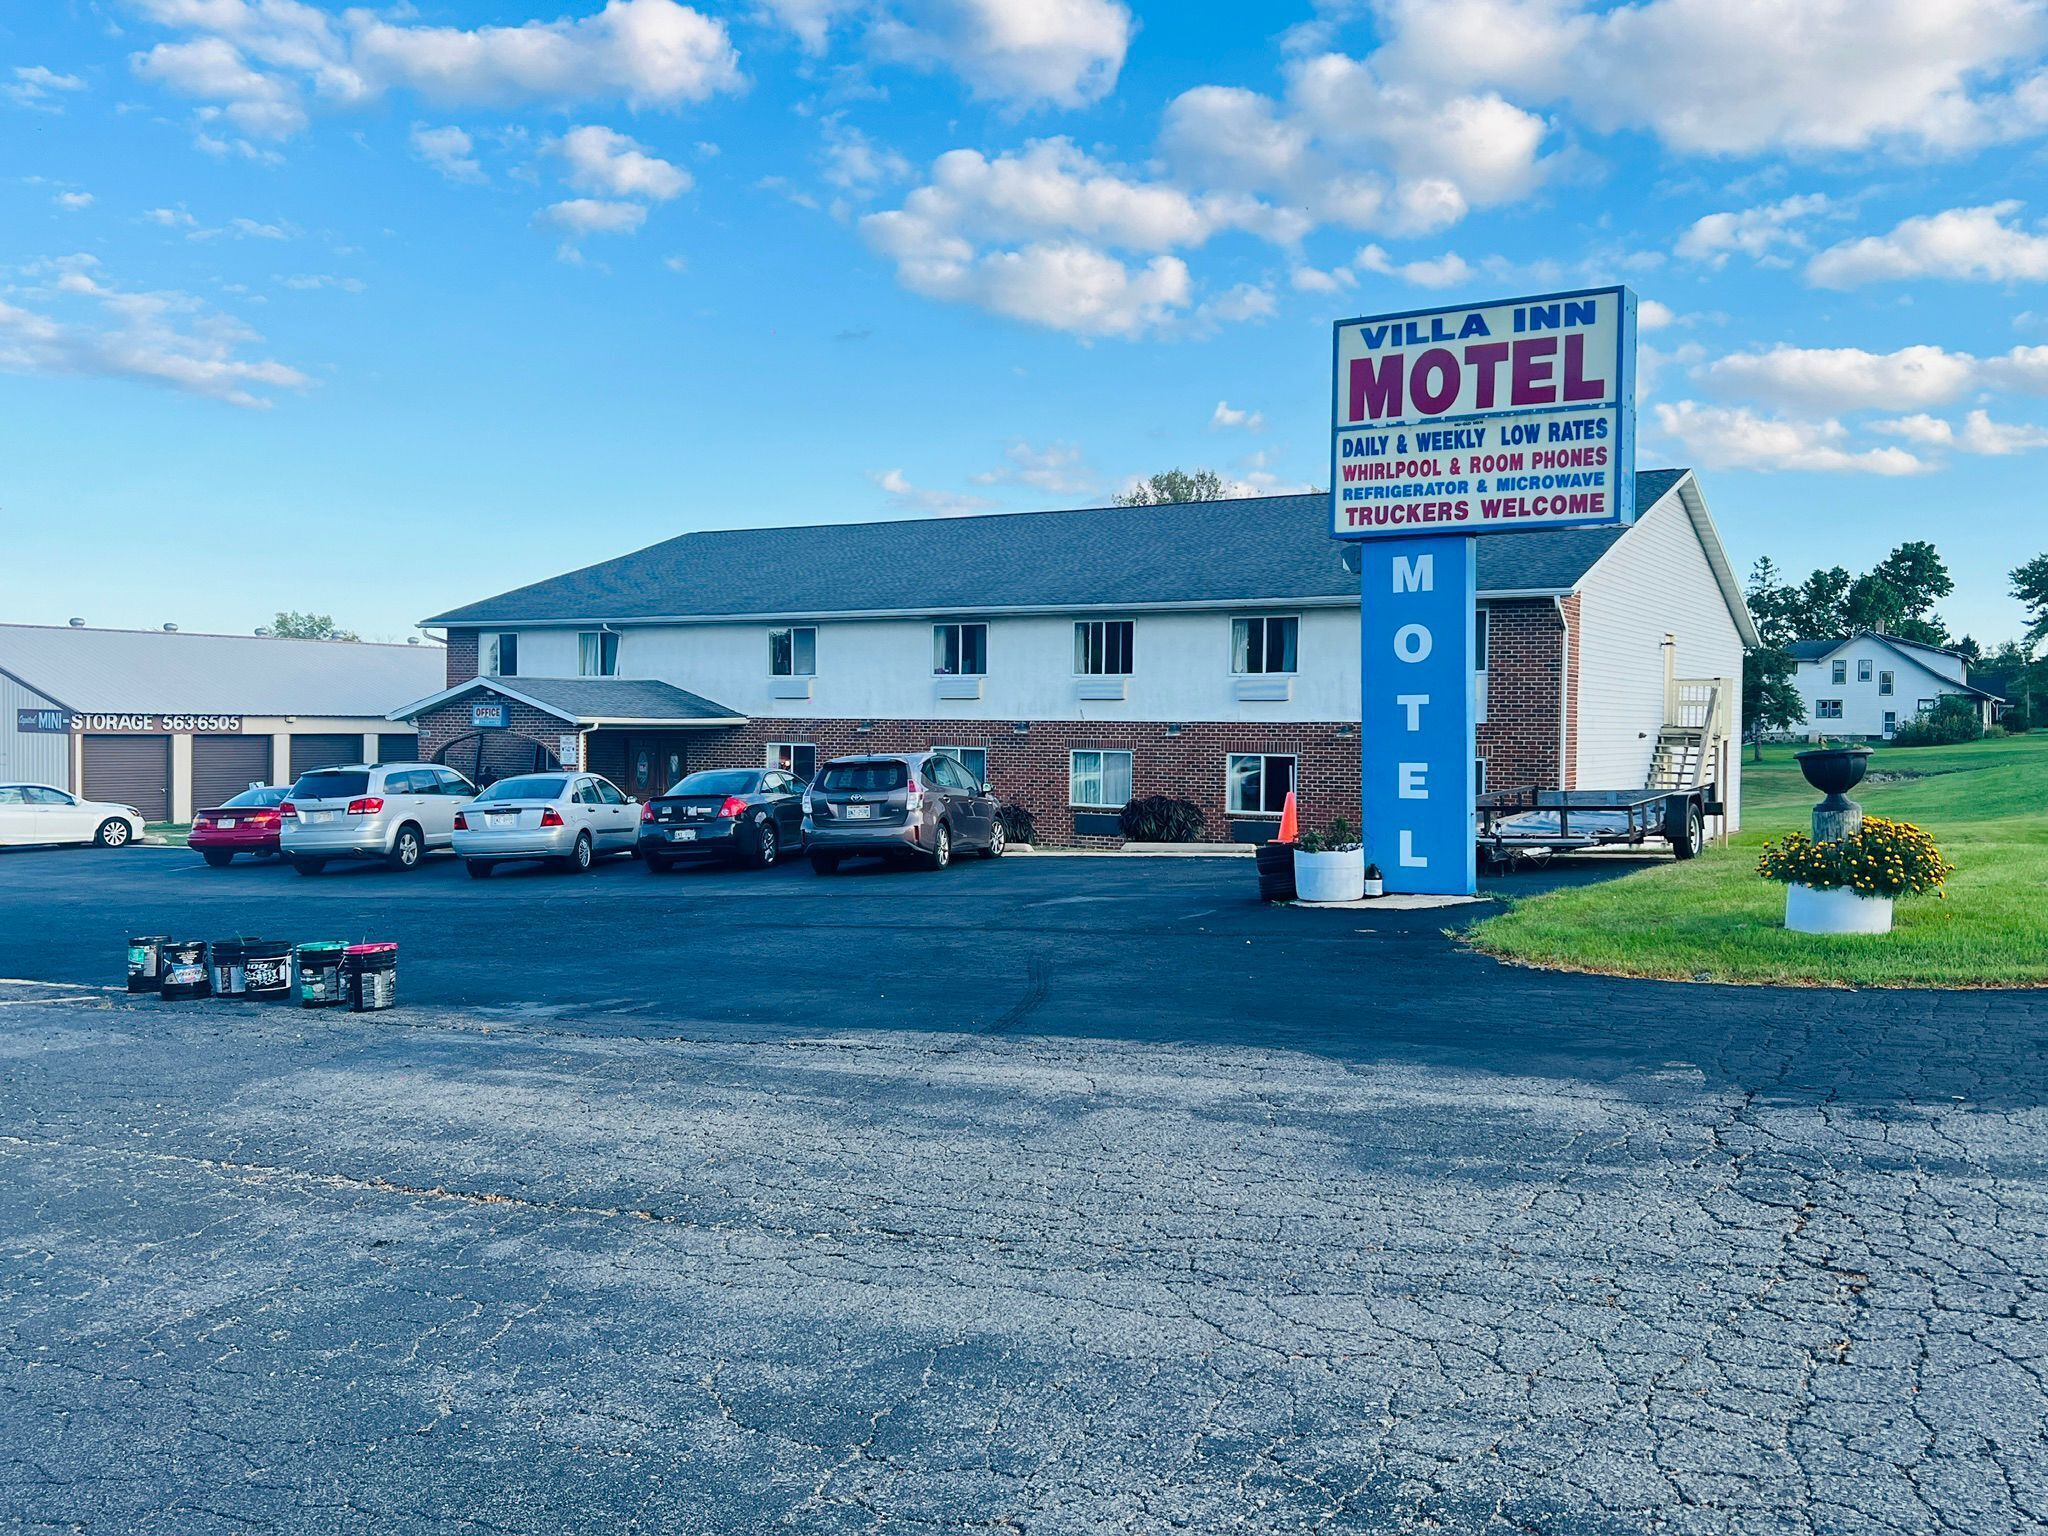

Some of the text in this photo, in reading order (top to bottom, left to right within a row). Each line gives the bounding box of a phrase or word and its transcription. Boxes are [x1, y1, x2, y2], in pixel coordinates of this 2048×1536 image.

[1360, 300, 1596, 350] VILLA INN
[1348, 333, 1605, 422] MOTEL
[1342, 417, 1608, 458] DAILY & WEEKLY LOW RATES
[1342, 446, 1608, 482] WHIRLPOOL & ROOM PHONES
[1342, 471, 1605, 501] REFRIGERATOR & MICROWAVE
[1345, 493, 1605, 526] TRUCKERS WELCOME
[476, 708, 500, 717] OFFICE
[1392, 554, 1434, 868] MOTEL
